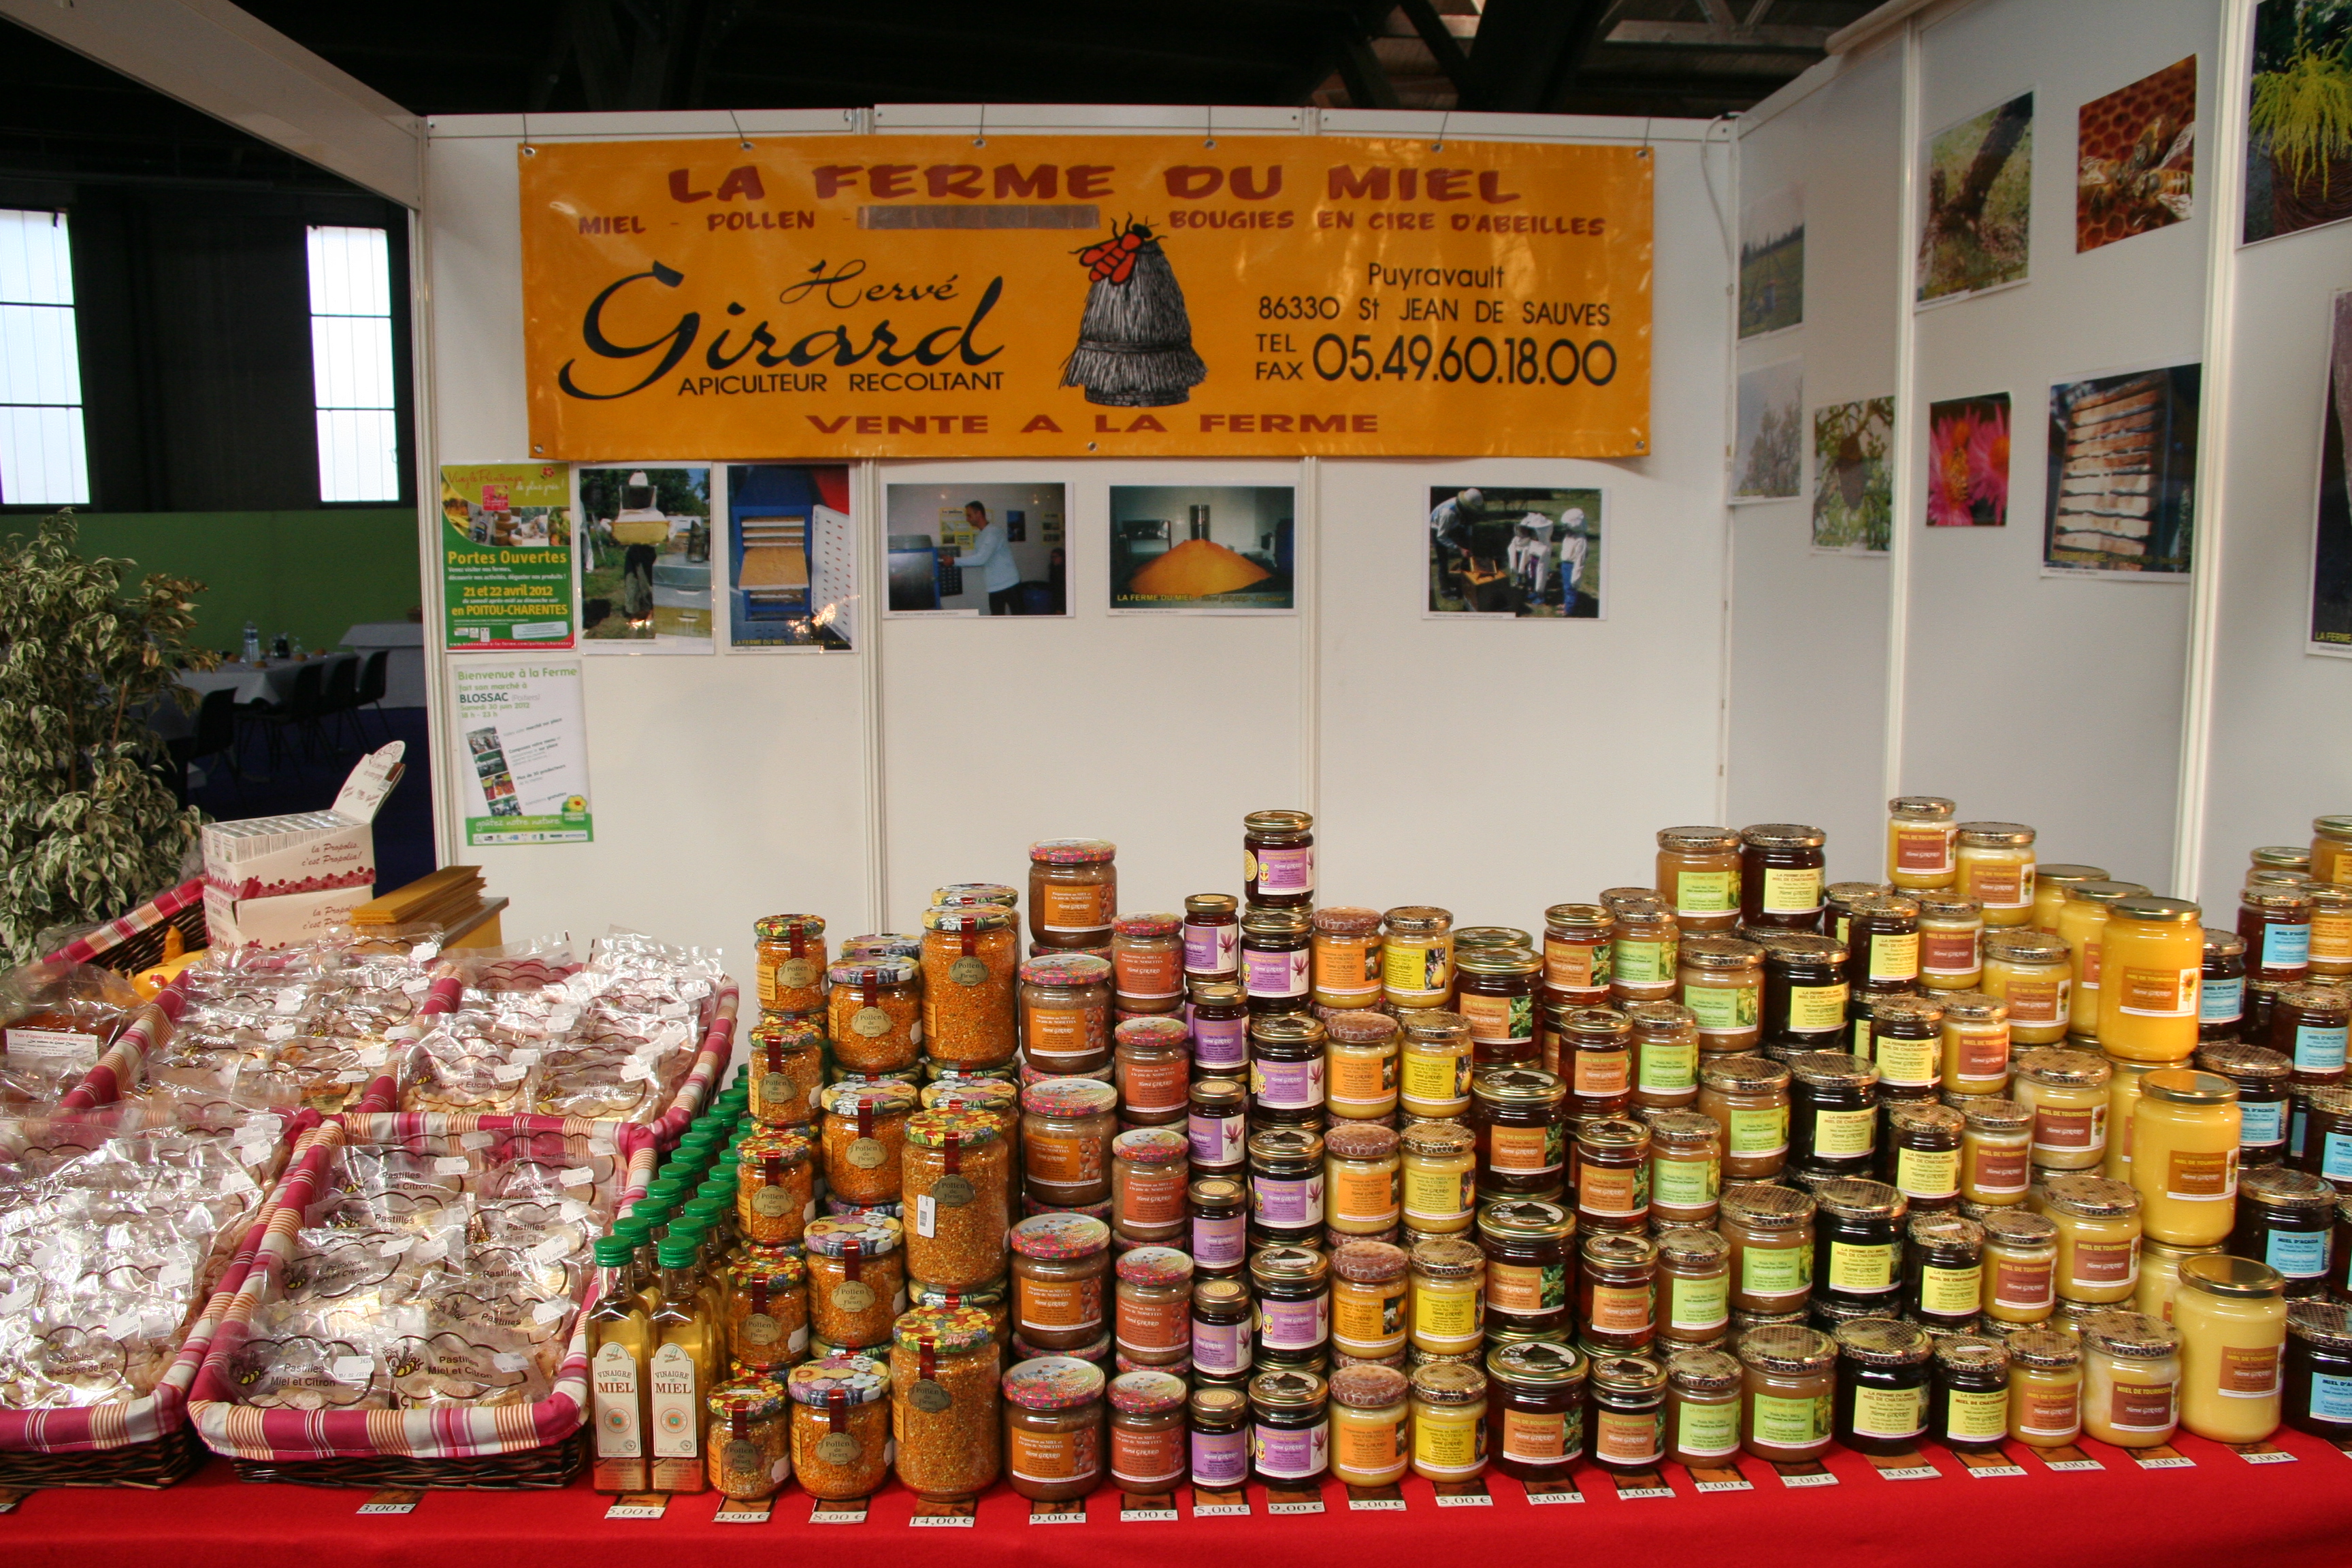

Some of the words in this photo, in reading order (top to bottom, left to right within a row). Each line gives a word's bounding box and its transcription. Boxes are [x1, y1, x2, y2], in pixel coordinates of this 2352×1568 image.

[668, 166, 765, 202] LA
[813, 165, 1115, 199] FERME
[1164, 165, 1282, 200] DU
[1328, 165, 1521, 202] MIEL
[578, 215, 647, 235] MIEL
[708, 211, 815, 231] POLLEN
[1169, 210, 1295, 230] BOUGIES
[1317, 211, 1354, 230] EN
[1368, 212, 1435, 230] CIRE
[1450, 212, 1607, 236] D'ABEILLES
[1368, 262, 1504, 293] Puyravault
[779, 259, 959, 309] Hervé
[1258, 295, 1341, 321] 86330
[1358, 297, 1380, 321] St
[1399, 298, 1458, 322] JEAN
[1475, 300, 1503, 323] DE
[1522, 301, 1611, 327] SAUVES
[558, 259, 1004, 401] Girard
[1256, 333, 1296, 353] TEL
[1312, 332, 1618, 387] 05.49.60.18.00
[1255, 361, 1303, 381] FAX
[677, 372, 828, 396] APICULTEUR
[849, 370, 1004, 391] RECOLTANT
[804, 414, 989, 435] VENTE
[1020, 414, 1063, 434] A
[1095, 414, 1168, 434] LA
[1199, 413, 1379, 434] FERME
[448, 551, 496, 564] Portes
[500, 551, 567, 564] Ouvertes
[463, 586, 475, 597] 21
[477, 586, 487, 596] et
[490, 586, 502, 597] 22
[503, 584, 527, 596] avril
[529, 586, 553, 596] 2012
[451, 607, 464, 616] en
[466, 604, 568, 615] POITOU-CHARENTES
[457, 668, 515, 681] Bienvenue
[519, 668, 526, 678] à
[529, 668, 540, 678] la
[542, 667, 577, 677] Ferme
[459, 693, 509, 703] BLOSSAC
[312, 845, 321, 853] la
[382, 1171, 421, 1180] Pastilles
[374, 1213, 415, 1224] Pastilles
[506, 1223, 546, 1231] Pastilles
[483, 1269, 523, 1279] Pastilles
[59, 1353, 94, 1364] Pastilles
[66, 1365, 86, 1375] Sève
[101, 1362, 114, 1371] Pin
[284, 1363, 324, 1373] Pastilles
[427, 1366, 449, 1375] Miel
[451, 1367, 462, 1375] et
[465, 1367, 493, 1379] Citron
[598, 1369, 632, 1379] VINAIGRE
[655, 1370, 689, 1379] VINAIGRE
[270, 1376, 292, 1386] Miel
[293, 1377, 301, 1386] et
[305, 1377, 336, 1387] Citron
[598, 1382, 634, 1393] MIEL
[655, 1383, 691, 1394] MIEL
[2142, 1458, 2174, 1467] 5,00
[2243, 1455, 2277, 1463] 8,00
[2050, 1461, 2085, 1469] 3,00
[1883, 1468, 1916, 1477] 8,00
[1921, 1467, 1933, 1475] €
[1784, 1475, 1818, 1484] 8,00
[1699, 1482, 1733, 1490] 4,00
[1439, 1497, 1473, 1505] 5,00
[1531, 1494, 1568, 1503] 8,00
[359, 1504, 396, 1512] 3,00
[1196, 1506, 1231, 1515] 5,00
[1237, 1505, 1248, 1513] €
[1271, 1504, 1306, 1512] 9,00
[1311, 1503, 1324, 1512] €
[715, 1513, 752, 1522] 4,00
[755, 1512, 768, 1520] €
[813, 1513, 849, 1521] 8,00
[911, 1516, 956, 1526] 14,00
[962, 1517, 974, 1525] €
[1031, 1514, 1068, 1522] 9,00
[1073, 1513, 1084, 1521] €
